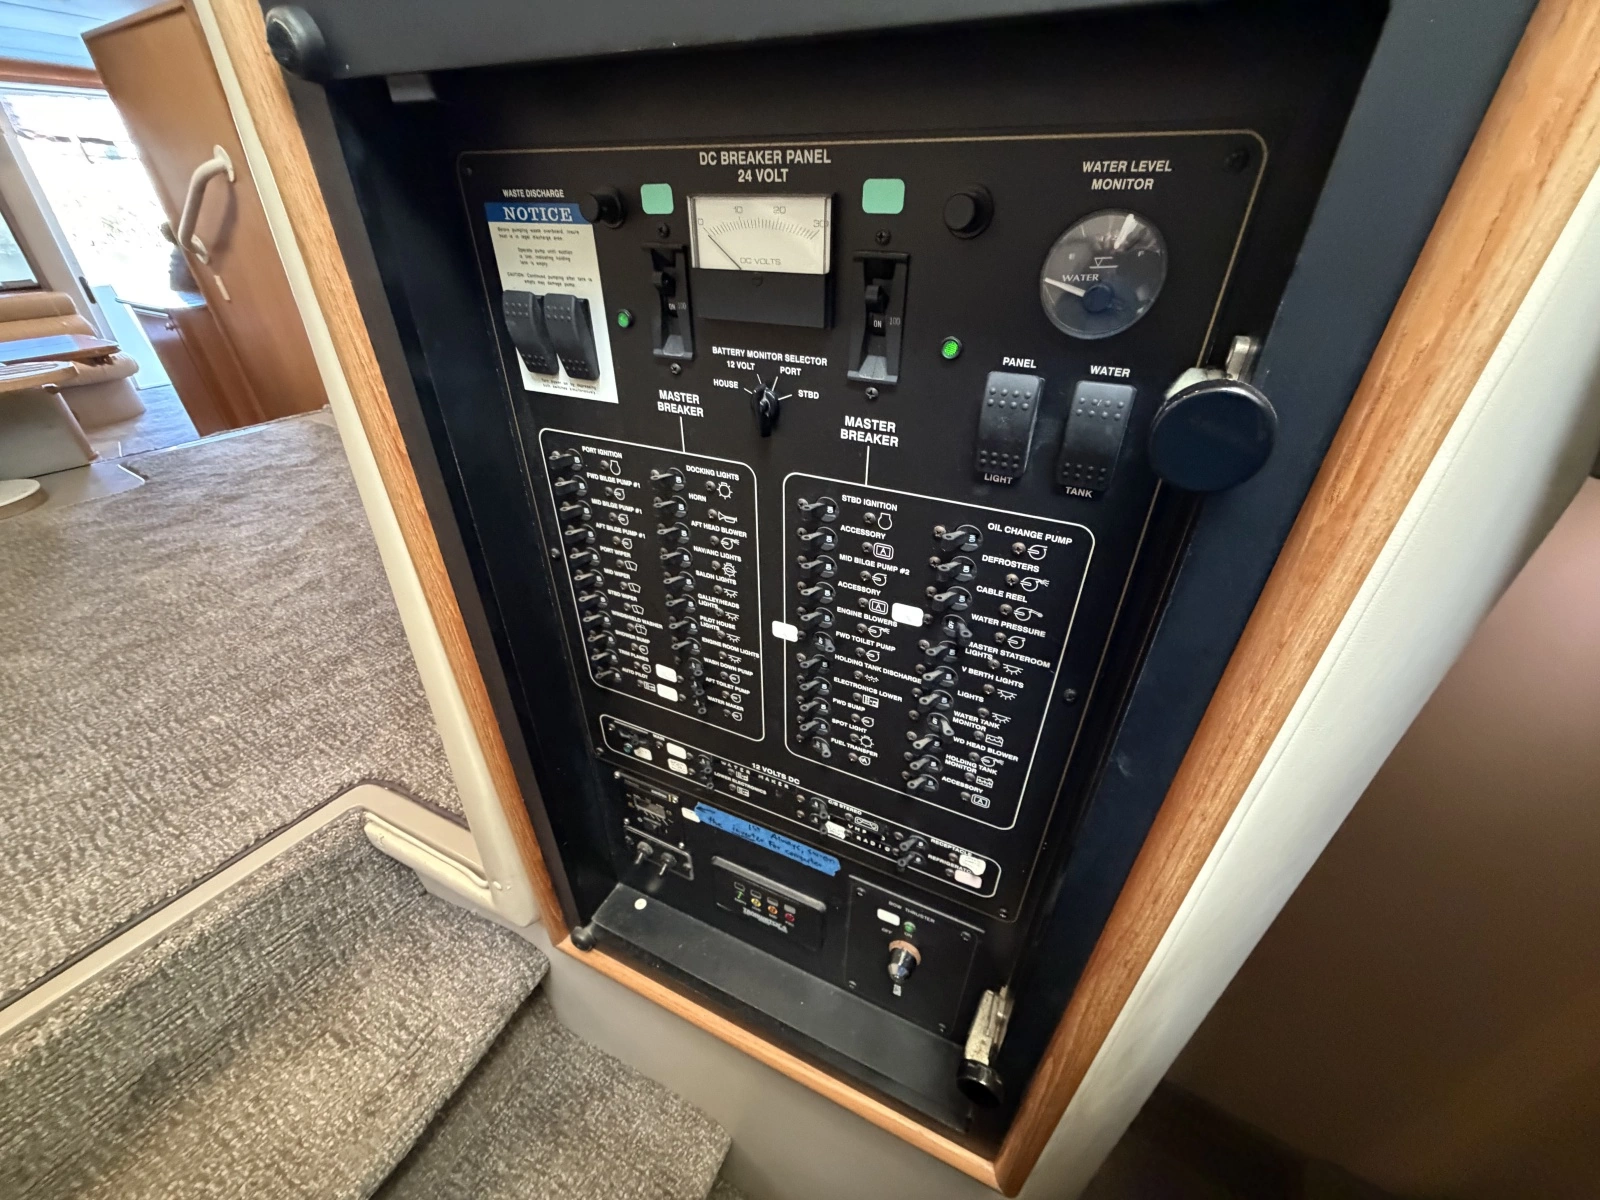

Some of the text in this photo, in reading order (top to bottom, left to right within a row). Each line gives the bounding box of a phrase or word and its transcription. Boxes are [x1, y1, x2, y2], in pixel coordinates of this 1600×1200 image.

[700, 149, 831, 165] DC BREAKER PANEL
[1082, 160, 1172, 173] WATER LEVEL
[738, 168, 788, 182] 24 VOLT
[1091, 179, 1154, 190] MONITOR
[502, 189, 564, 198] WASTE DISCHARGE
[503, 207, 573, 221] NOTICE
[734, 206, 743, 214] 10
[773, 206, 786, 214] 20
[813, 220, 829, 228] 30
[1062, 274, 1099, 282] WATER
[669, 303, 675, 311] ON
[873, 320, 882, 328] ON
[712, 346, 828, 366] BATTERY MONITOR SELECTOR
[1003, 357, 1037, 368] PANEL
[727, 360, 755, 371] 12 VOLT
[780, 367, 802, 376] PORT
[1090, 365, 1130, 378] WATER
[713, 379, 738, 389] HOUSE
[659, 390, 700, 404] MASTER
[798, 390, 819, 399] STBD
[658, 402, 704, 417] BREAKER
[845, 416, 896, 433] MASTER
[840, 429, 899, 447] BREAKER
[582, 446, 622, 459] PORT IGNITION
[587, 472, 598, 480] FWD
[600, 475, 616, 483] BILGE
[686, 465, 739, 480] DOCKING LIGHTS
[984, 473, 1013, 484] LIGHT
[688, 493, 706, 502] HORN
[1065, 487, 1092, 498] TANK
[591, 498, 601, 506] MID
[603, 501, 618, 509] BILGE
[619, 505, 634, 513] PUMP
[842, 494, 897, 511] STBD IGNITION
[606, 525, 622, 533] BILGE
[703, 522, 720, 532] HEAD
[721, 526, 747, 538] BLOWER
[840, 525, 886, 540] ACCESSORY
[988, 523, 1073, 545] OIL CHANGE PUMP
[600, 546, 631, 558] PORT WIPER
[720, 552, 742, 562] LIGHTS
[839, 554, 910, 576] MID BILGE PUMP #2
[982, 555, 1040, 573] DEFROSTERS
[615, 570, 630, 579] WIPER
[696, 570, 737, 585] SALON LIGHTS
[838, 581, 881, 596] ACCESSORY
[976, 585, 1027, 603] CABLE REEL
[698, 593, 740, 609] GALLEY/HEADS
[698, 600, 718, 609] LIGHTS
[700, 615, 736, 630] PILOT HOUSE
[837, 606, 897, 627] ENGINE BLOWERS
[700, 622, 720, 631] LIGHTS
[972, 613, 1046, 637] WATER PRESSURE
[702, 637, 760, 658] ENGINE ROOM LIGHTS
[836, 631, 896, 652] FWD TOILET PUMP
[965, 648, 993, 660] LIGHTS
[1000, 650, 1050, 668] STATEROOM
[622, 667, 648, 679] AUTO PILOT
[703, 657, 719, 666] WASH
[738, 668, 753, 676] PUMP
[835, 654, 922, 684] HOLDING TANK DISCHARGE
[968, 668, 994, 680] BERTH
[995, 675, 1024, 688] LIGHTS
[834, 677, 902, 702] ELECTRONICS LOWER
[957, 690, 984, 702] LIGHTS
[833, 698, 866, 712] FWD SUMP
[832, 718, 867, 734] SPOT LIGHT
[952, 717, 986, 731] MONITOR
[954, 711, 1000, 729] WATER TANK
[831, 738, 878, 758] FUEL TRANSFER
[966, 741, 986, 751] HEAD
[988, 747, 1019, 762] BLOWER
[945, 759, 977, 774] MONITOR
[946, 754, 998, 775] HOLDING TANK
[762, 766, 786, 780] VOLTS
[788, 776, 800, 784] DC
[942, 776, 984, 794] ACCESSORY
